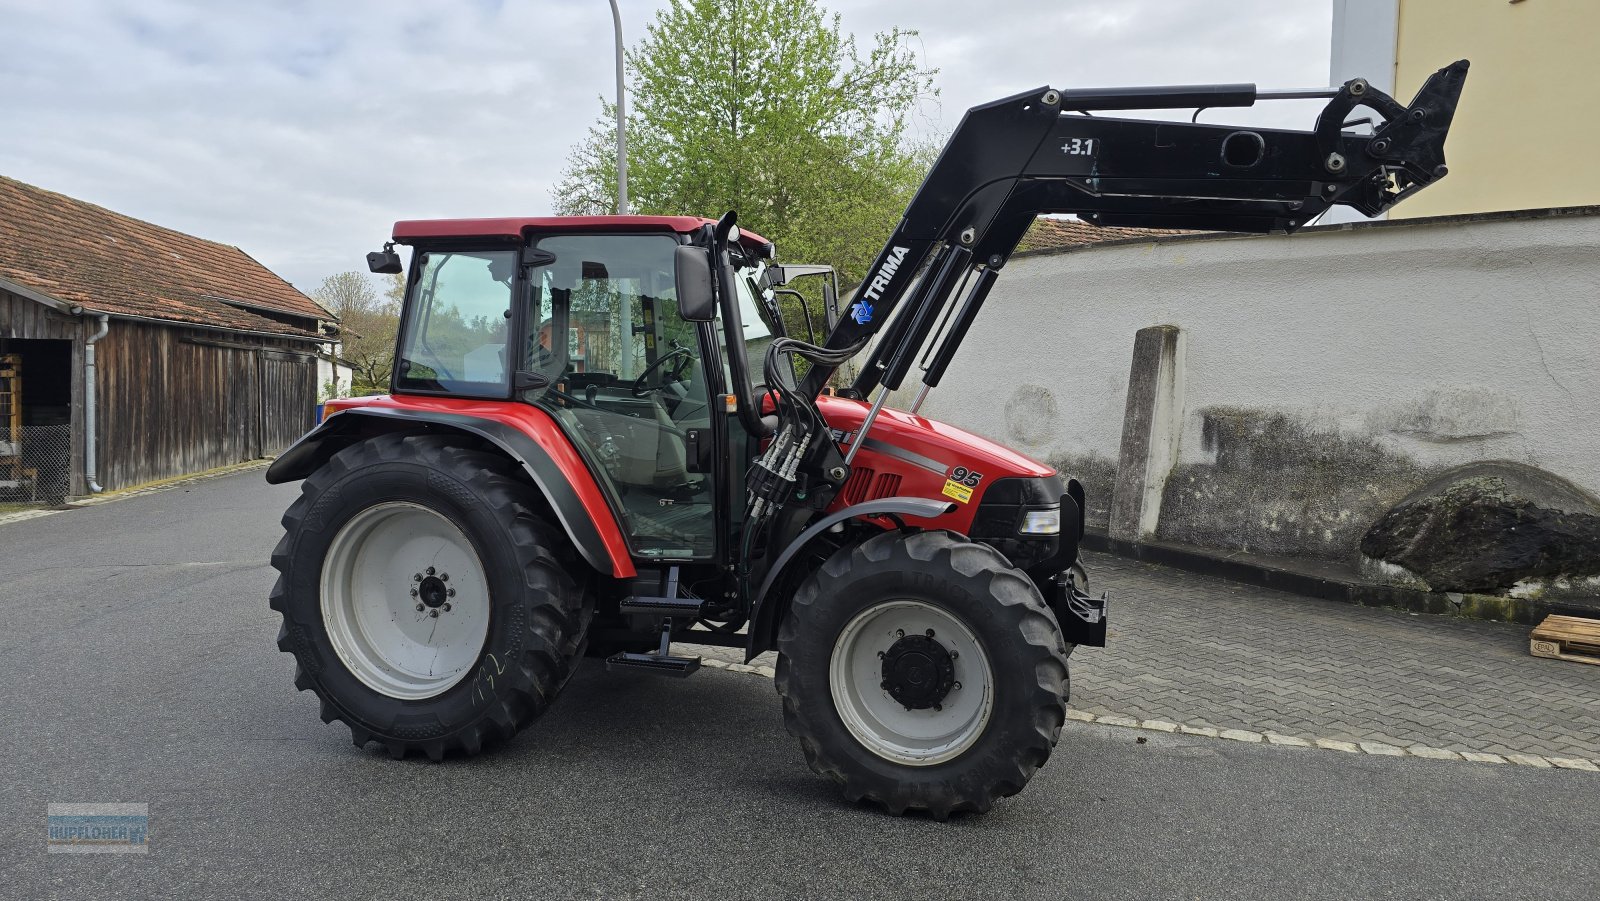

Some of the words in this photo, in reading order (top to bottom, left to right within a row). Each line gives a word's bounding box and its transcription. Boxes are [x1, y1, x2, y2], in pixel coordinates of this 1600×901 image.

[1061, 138, 1093, 155] +3.1
[864, 246, 910, 300] TRIMA
[950, 466, 984, 488] 95
